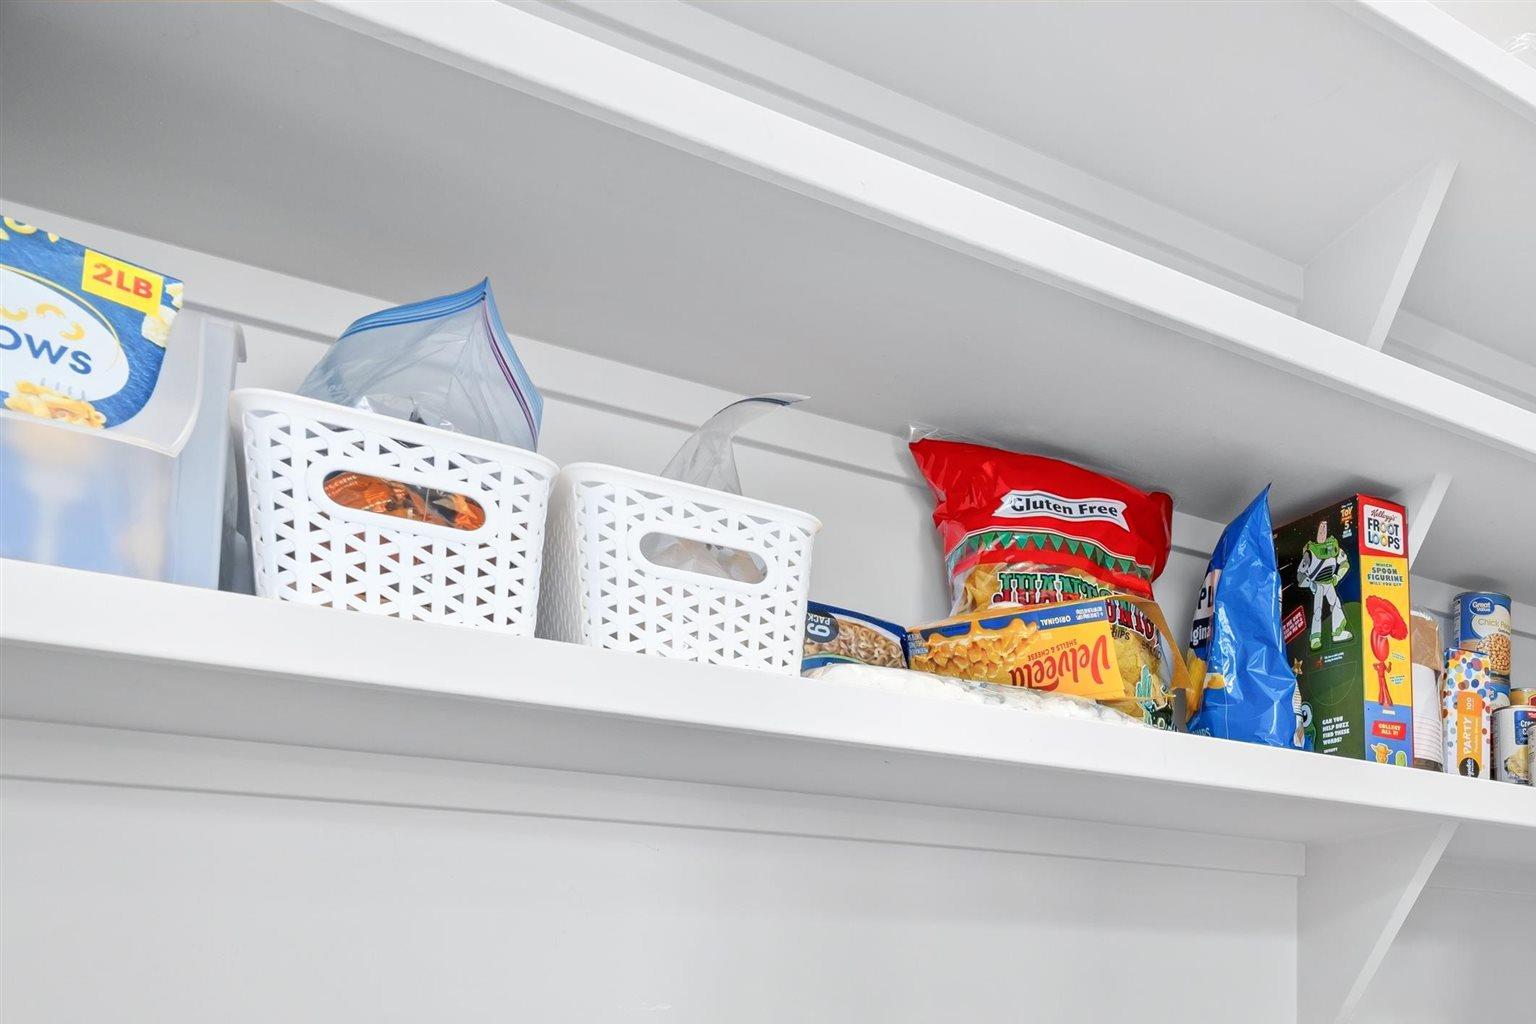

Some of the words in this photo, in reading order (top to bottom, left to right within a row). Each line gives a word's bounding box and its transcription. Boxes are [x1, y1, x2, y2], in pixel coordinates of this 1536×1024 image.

[93, 262, 153, 299] 2LB
[1011, 497, 1074, 515] Gluten
[1078, 503, 1119, 517] Free
[1367, 517, 1400, 537] FROOT
[1367, 531, 1401, 550] LOOPS
[1367, 574, 1404, 582] FIGURINE
[1372, 567, 1398, 575] SPOON
[1472, 601, 1491, 609] Great
[808, 612, 831, 626] PACK
[1040, 614, 1072, 626] ORIGINAL
[1056, 638, 1078, 651] SHELLS
[1028, 648, 1049, 662] CHEESE
[1462, 715, 1473, 755] PARTY
